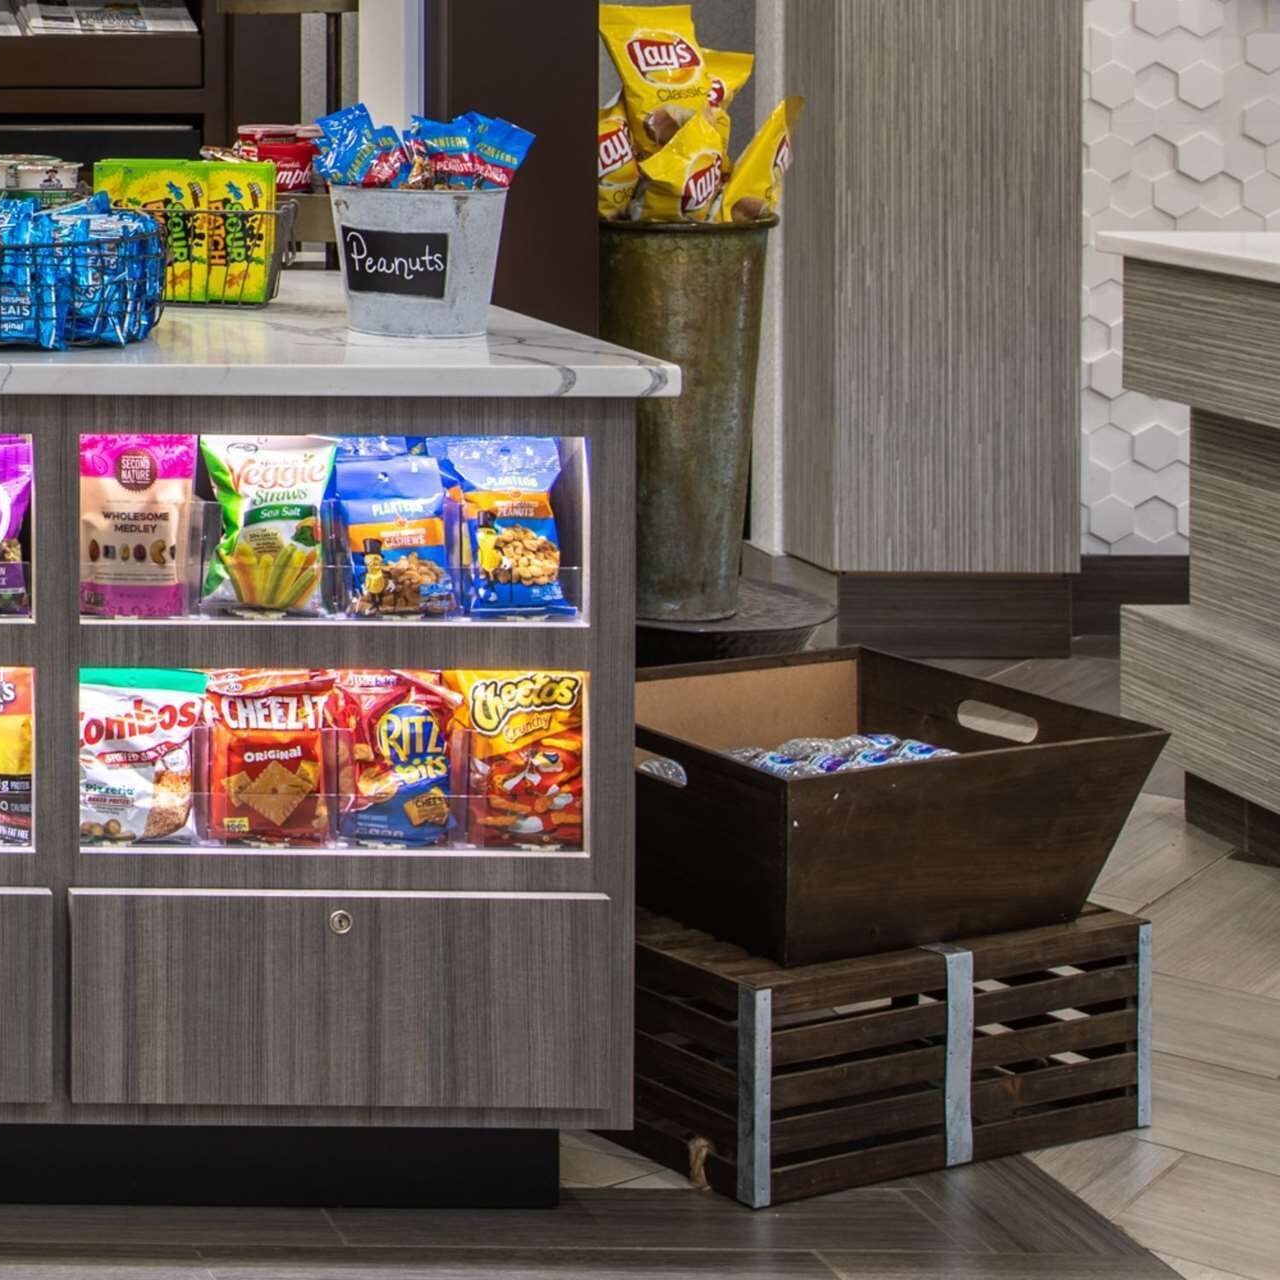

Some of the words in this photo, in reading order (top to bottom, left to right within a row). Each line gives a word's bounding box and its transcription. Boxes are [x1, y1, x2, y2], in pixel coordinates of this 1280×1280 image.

[633, 39, 692, 72] Lay's
[346, 230, 446, 281] Peanuts
[121, 456, 150, 469] SECOND
[121, 470, 150, 482] NATURE
[226, 458, 327, 491] Veggie
[252, 488, 308, 506] Straws
[102, 511, 169, 521] WHOLESOME
[260, 508, 280, 519] Sea
[281, 506, 302, 518] Salt
[114, 524, 157, 533] MEDLEY
[471, 673, 582, 735] Cheetos
[378, 713, 443, 763] RITZ
